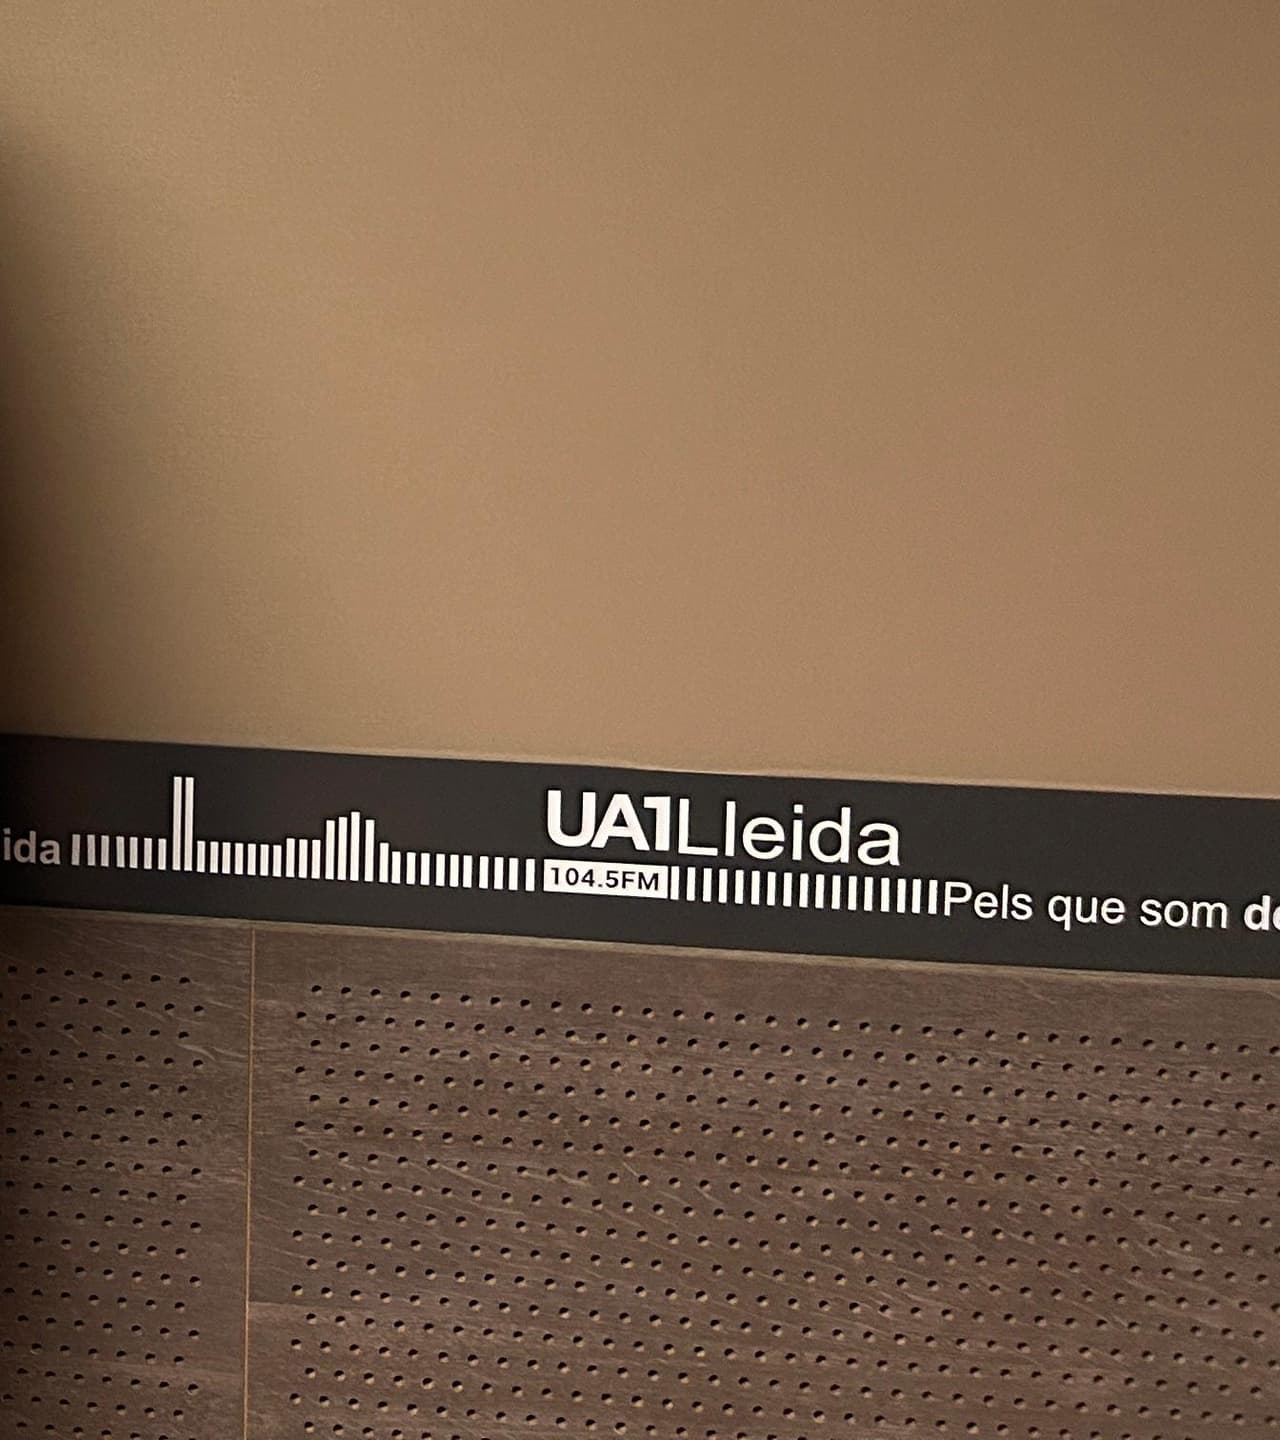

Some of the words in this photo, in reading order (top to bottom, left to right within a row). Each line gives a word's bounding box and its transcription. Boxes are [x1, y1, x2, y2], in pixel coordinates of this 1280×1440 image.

[550, 866, 660, 892] 104.5FM
[943, 879, 1034, 921] Pels
[1047, 893, 1126, 932] que
[1140, 897, 1229, 930] som
